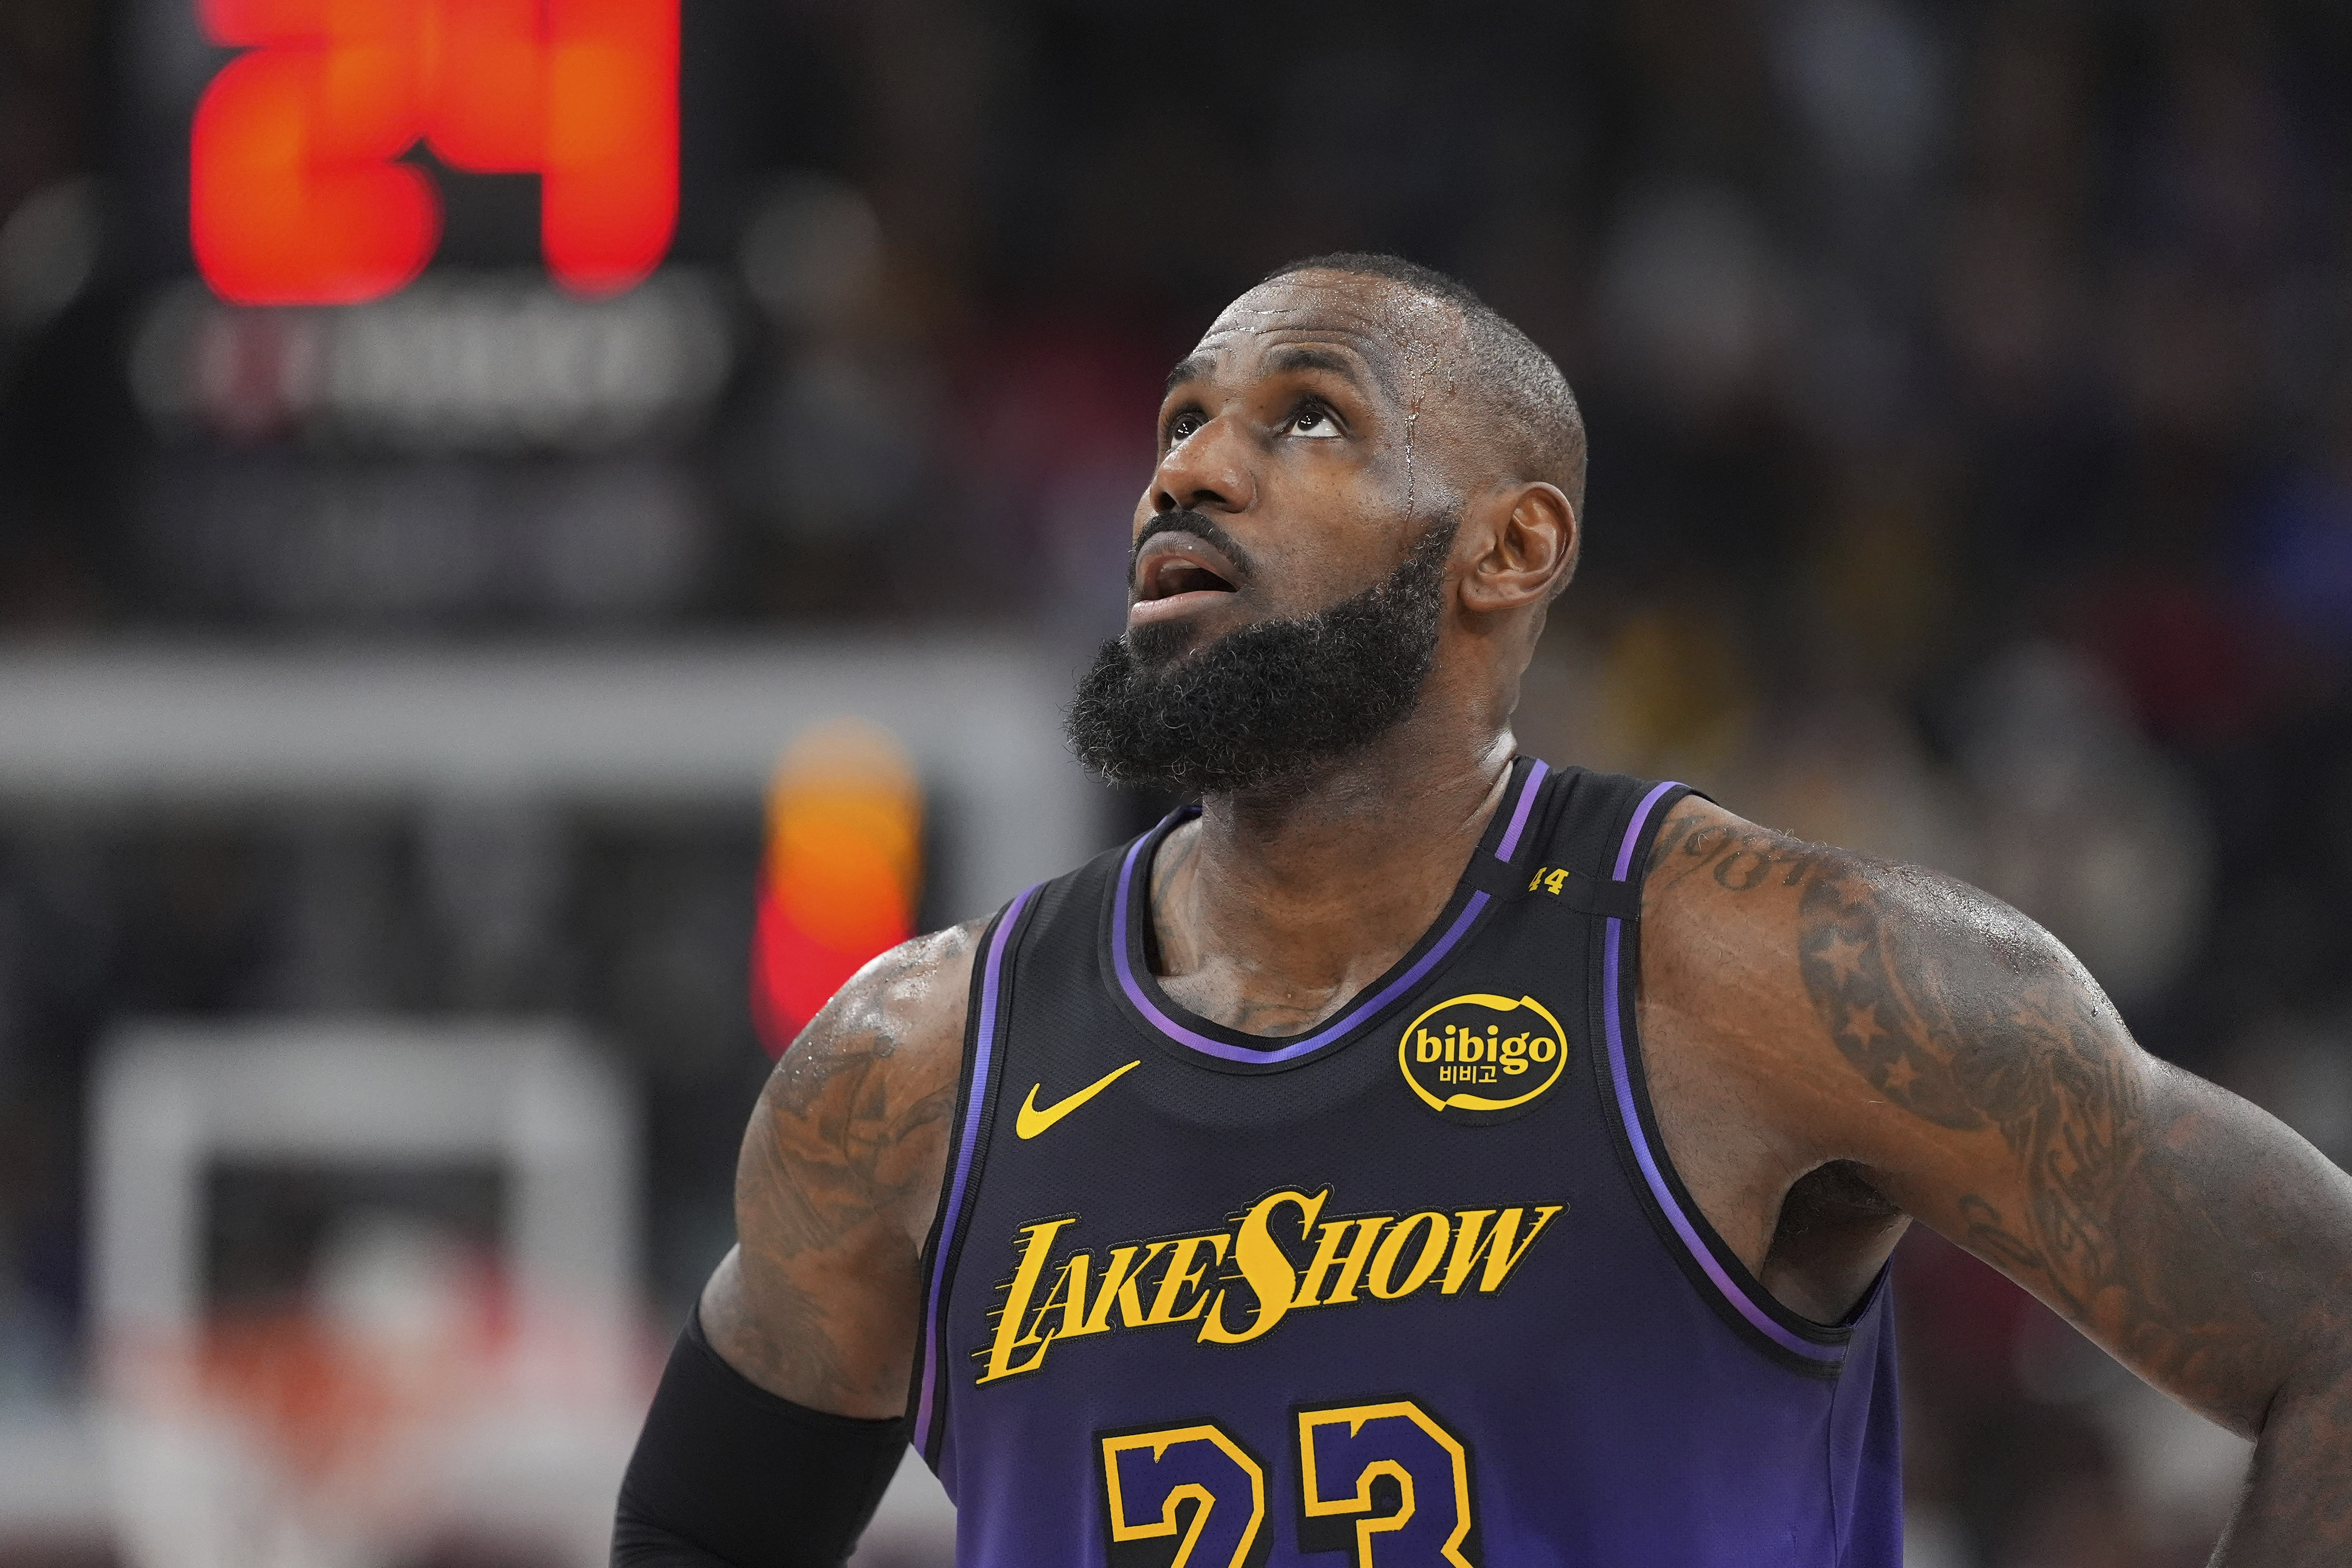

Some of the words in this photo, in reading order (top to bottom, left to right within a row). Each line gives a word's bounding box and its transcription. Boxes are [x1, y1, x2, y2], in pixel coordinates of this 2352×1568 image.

[189, 0, 681, 306] 24
[1528, 867, 1569, 895] 44
[1416, 1024, 1556, 1075] bibigo
[1439, 1066, 1497, 1084] 비비고
